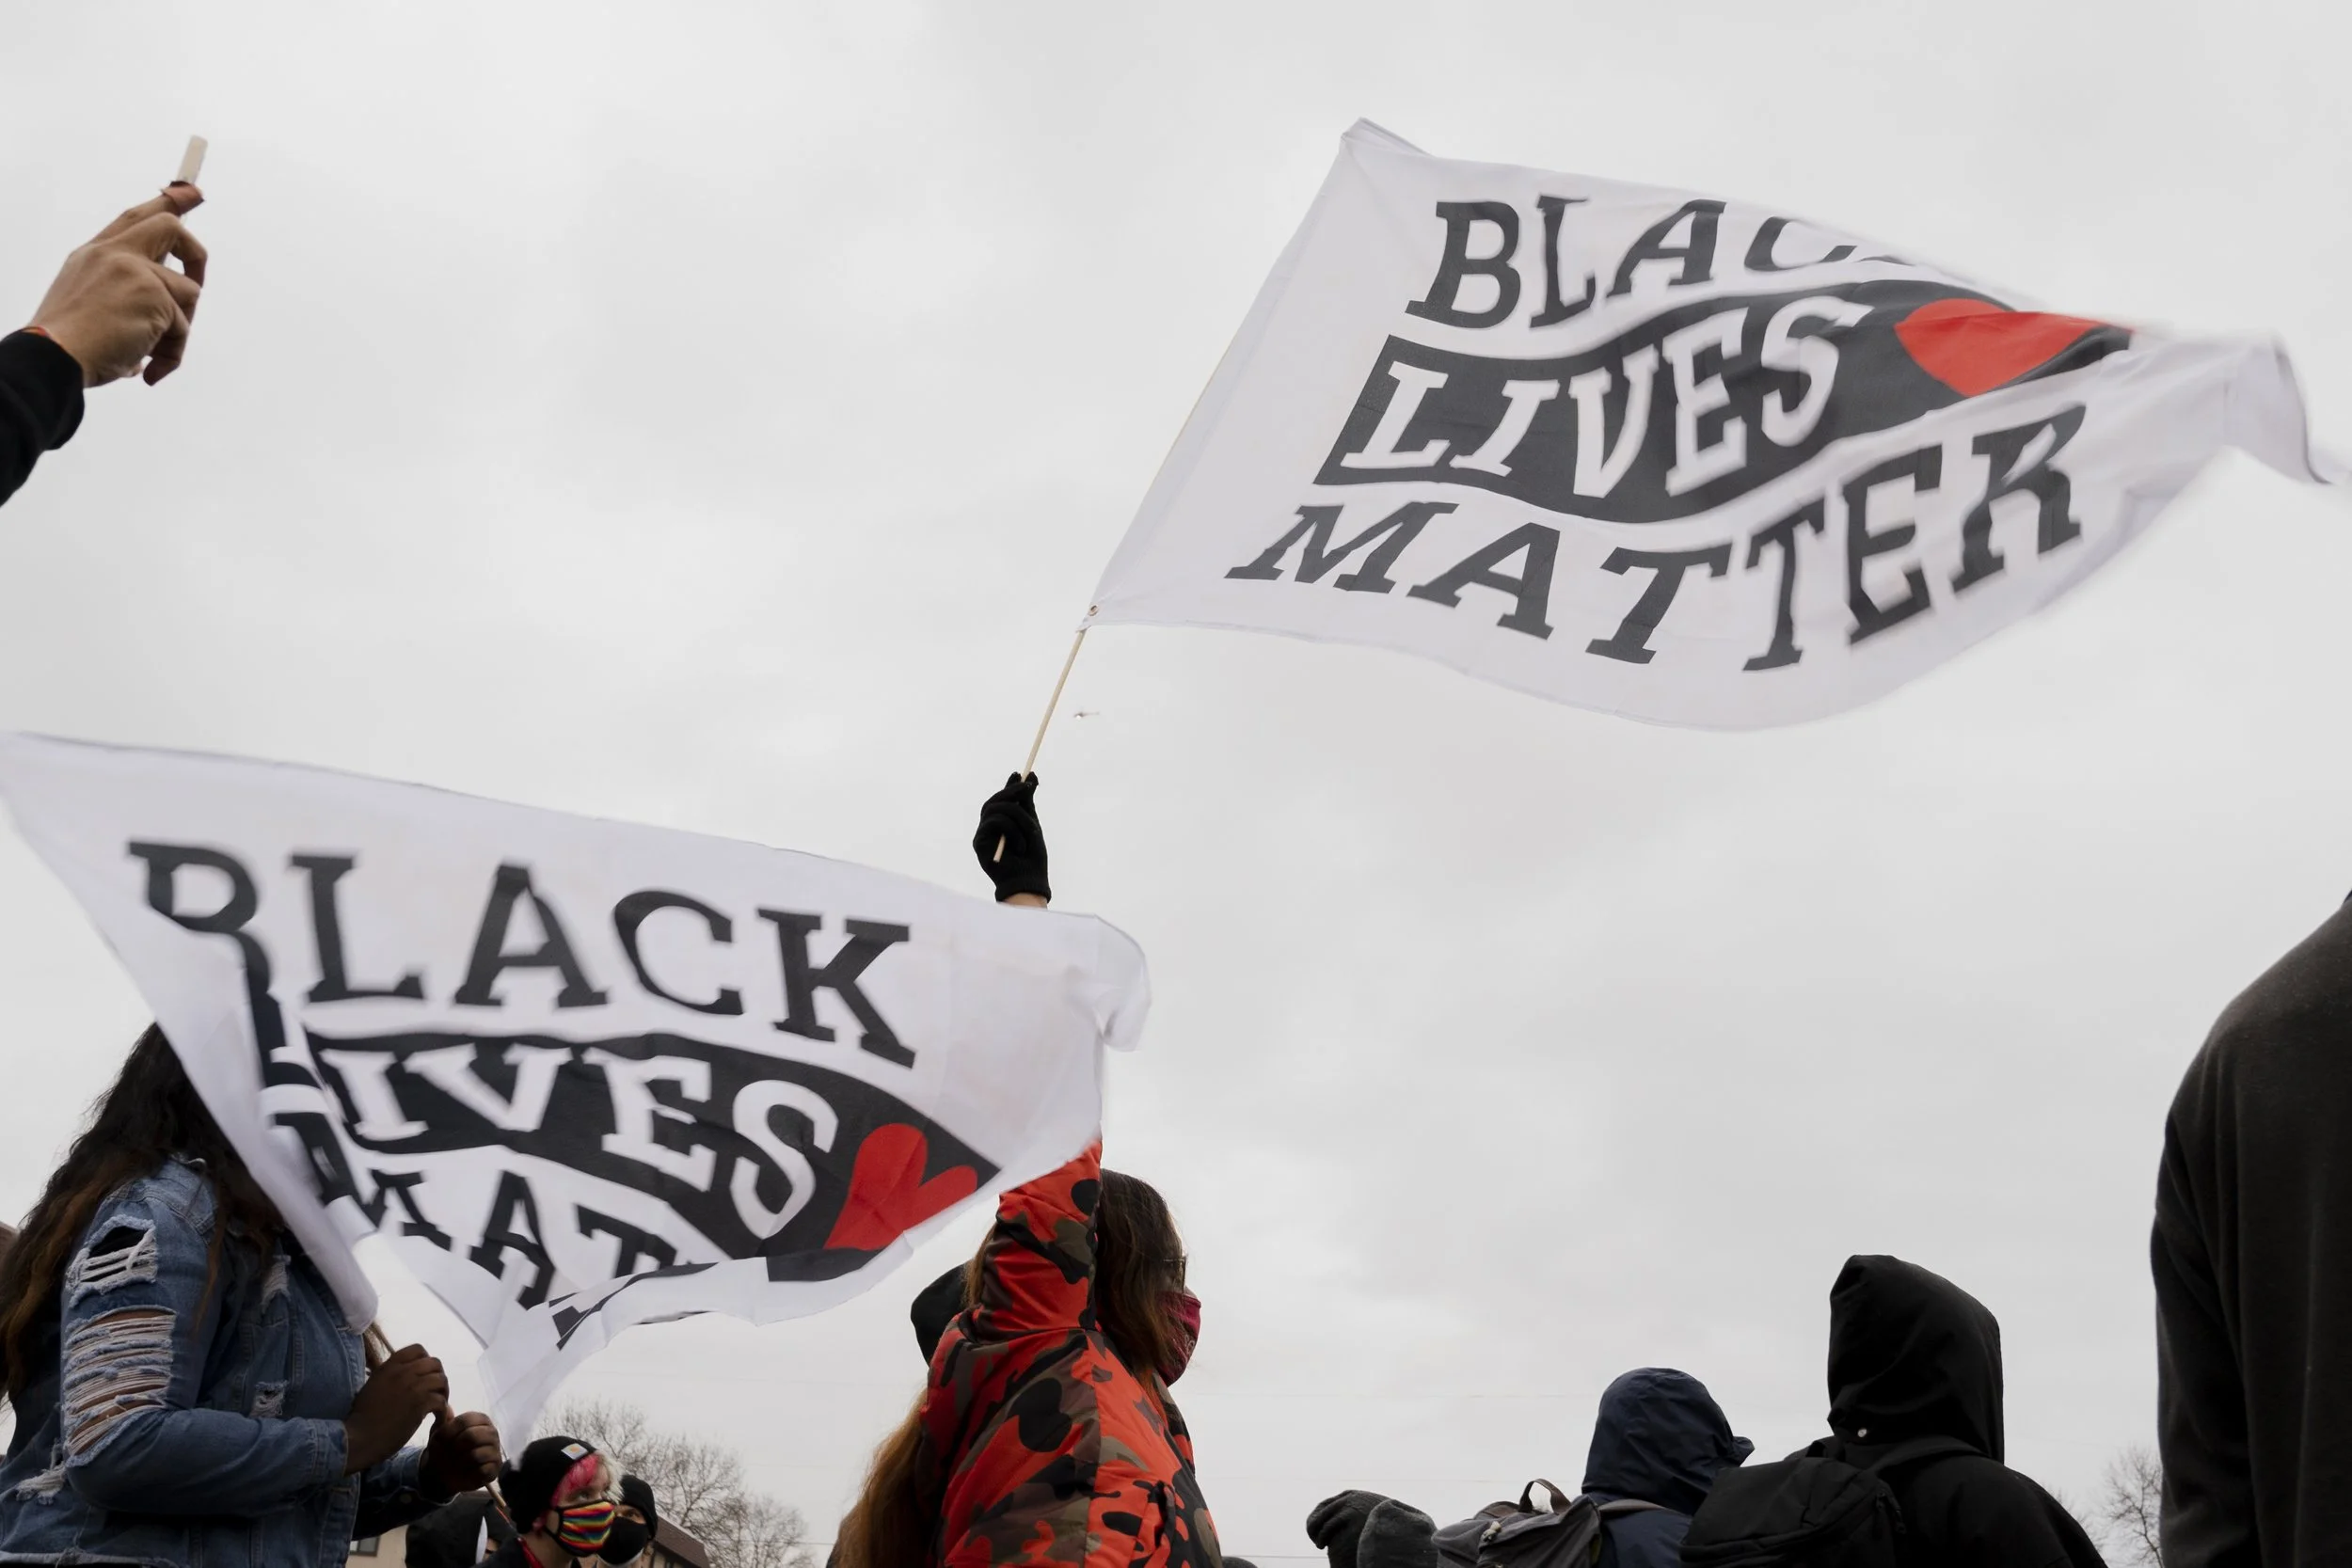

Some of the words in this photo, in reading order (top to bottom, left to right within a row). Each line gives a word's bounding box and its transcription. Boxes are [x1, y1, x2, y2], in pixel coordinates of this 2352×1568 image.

[1406, 195, 1915, 329] BLAC
[1340, 295, 1875, 498] LIVES
[1225, 404, 2087, 673] MATTER
